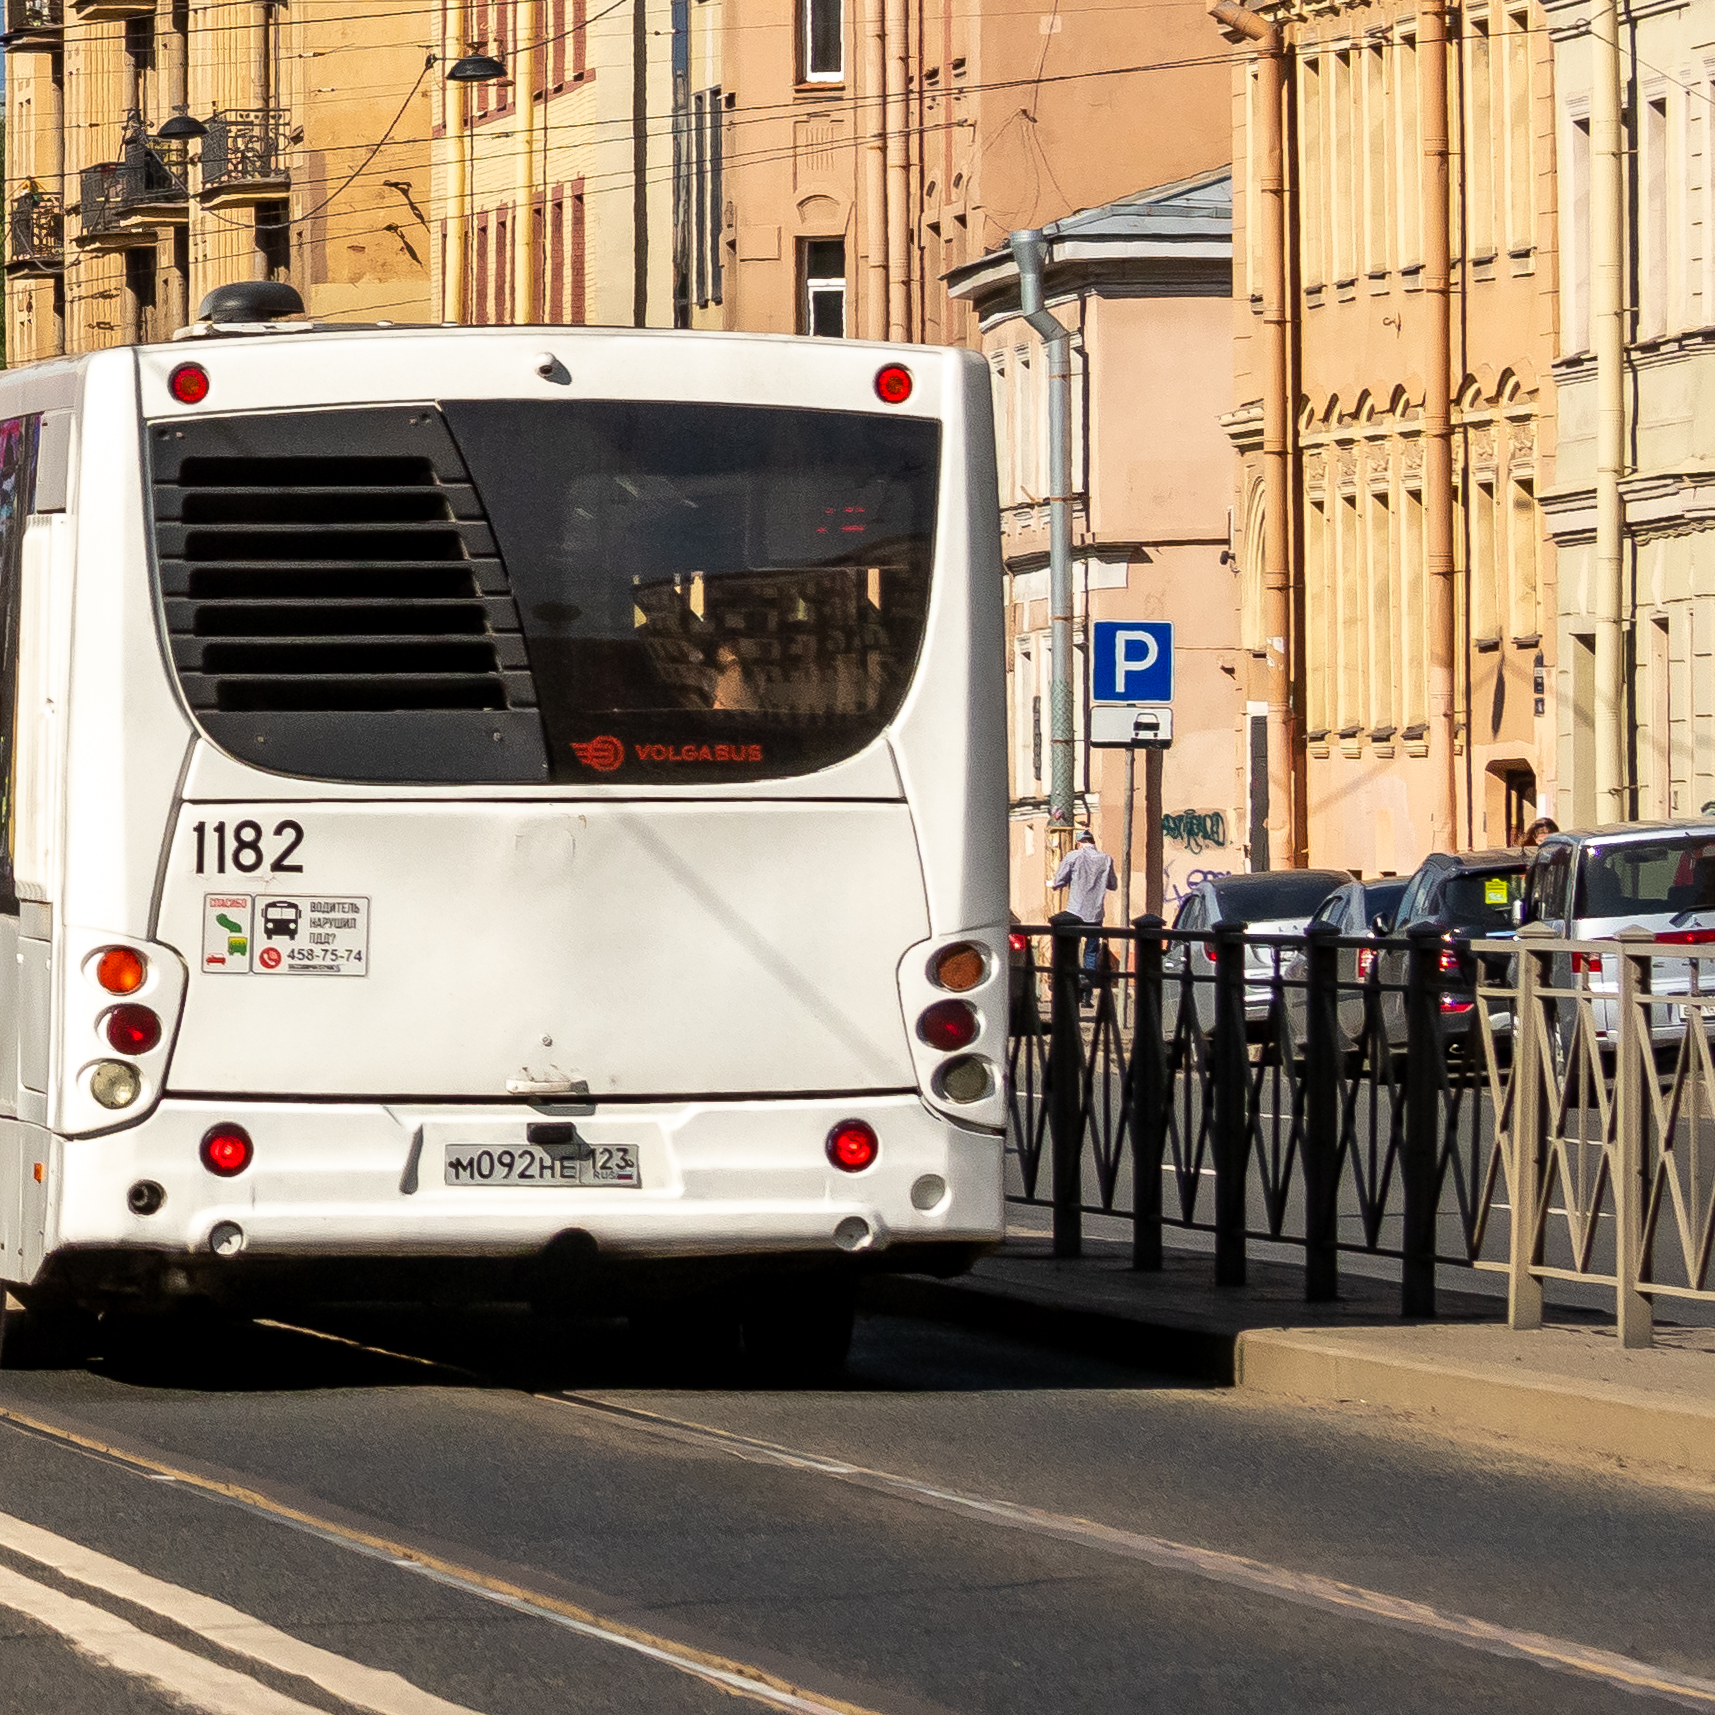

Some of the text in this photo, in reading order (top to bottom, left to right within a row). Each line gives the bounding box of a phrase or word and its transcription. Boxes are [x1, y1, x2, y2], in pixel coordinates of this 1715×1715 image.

[1115, 630, 1159, 693] P
[635, 744, 763, 762] VOLGABUS
[193, 819, 304, 874] 1182
[310, 901, 360, 914] ВОДИТЕЛЬ
[309, 932, 336, 945] ПДД?
[287, 948, 363, 963] 458-75-74
[589, 1147, 630, 1171] 123
[593, 1171, 618, 1180] RUS
